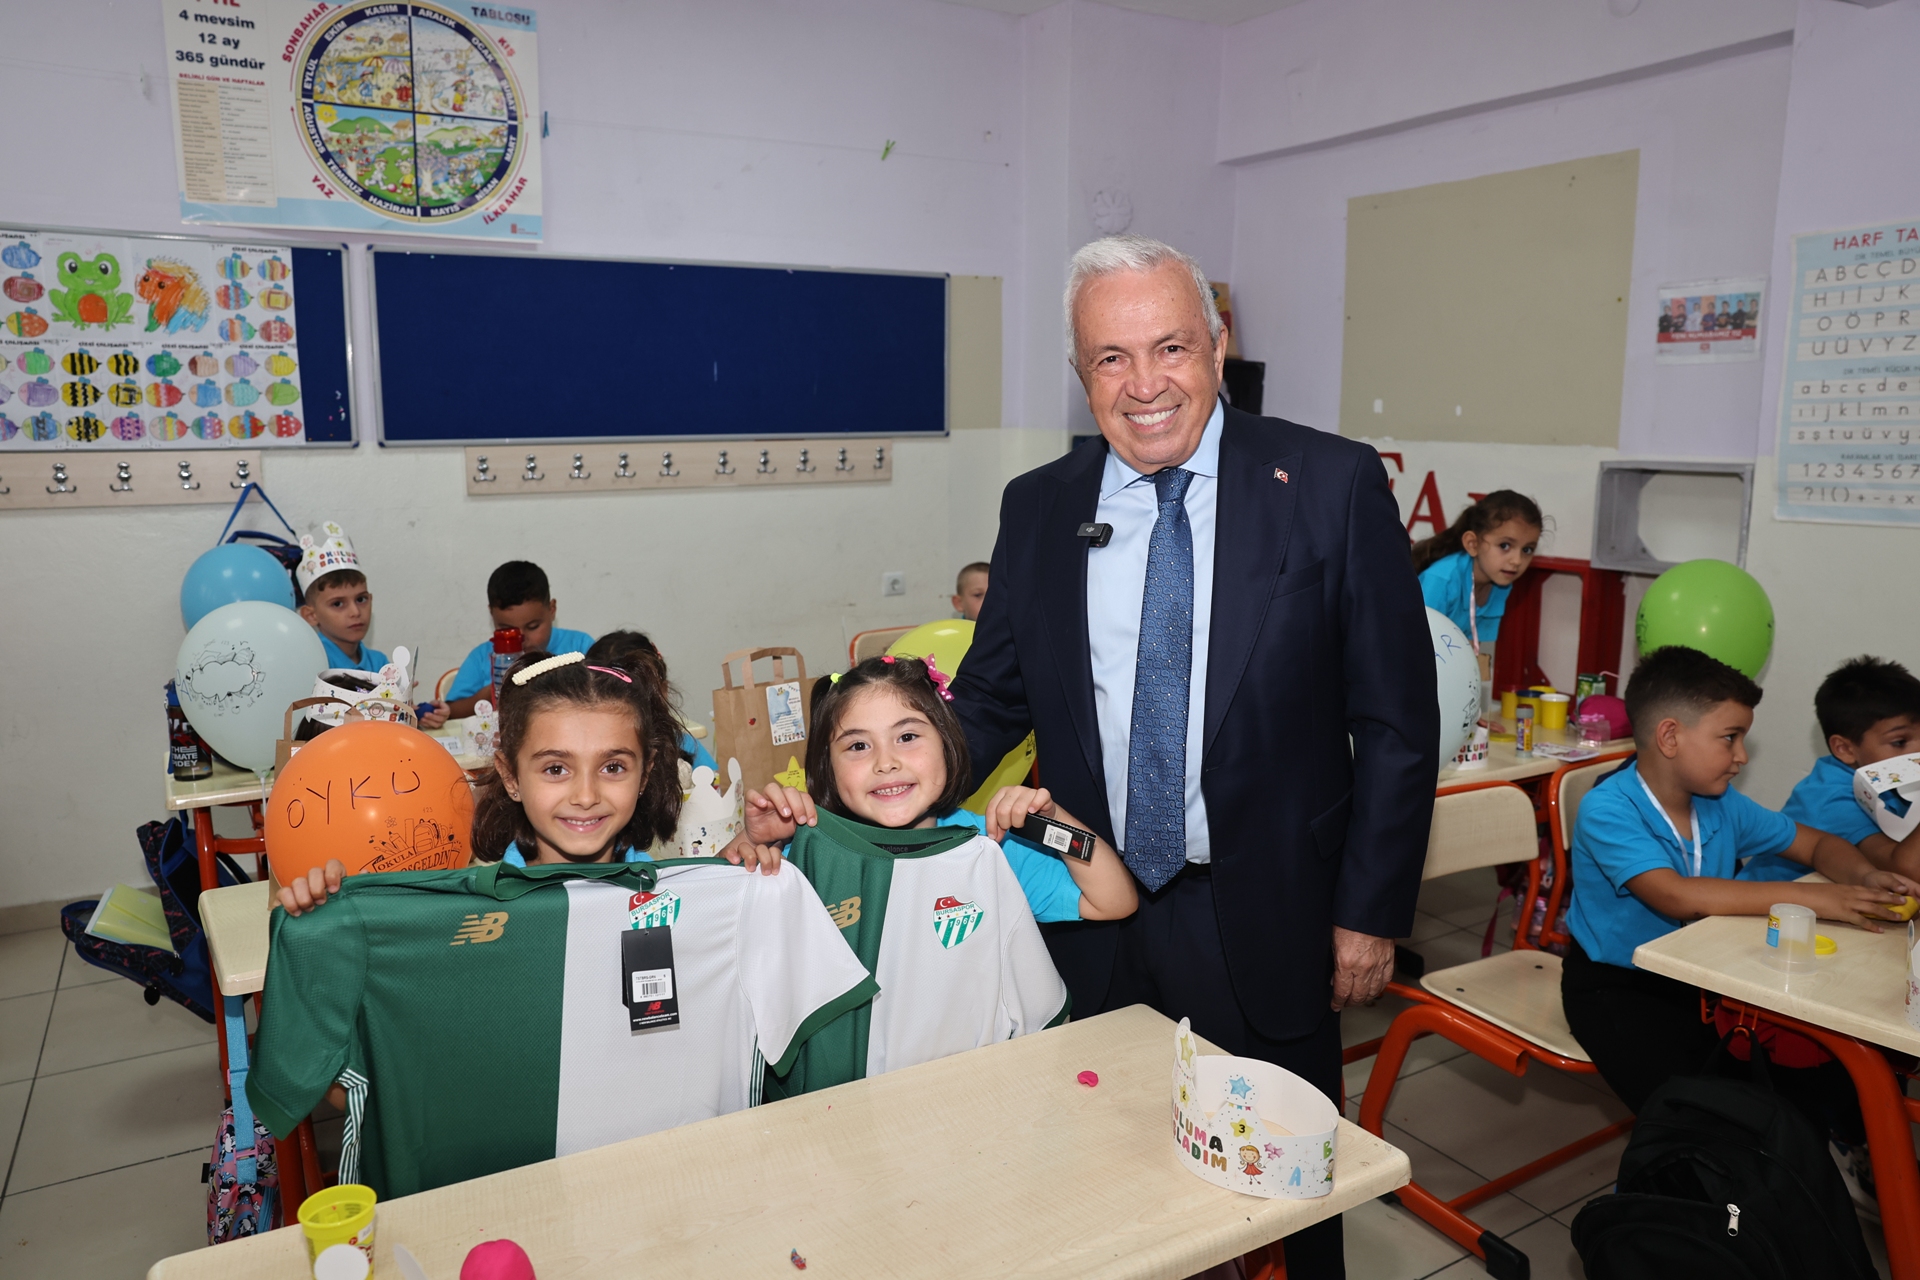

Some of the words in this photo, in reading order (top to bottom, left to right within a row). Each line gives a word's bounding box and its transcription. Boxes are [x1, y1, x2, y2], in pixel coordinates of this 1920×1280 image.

[178, 9, 189, 21] 4
[194, 13, 255, 29] mevsim
[364, 5, 398, 16] KASIM
[418, 8, 457, 28] ARALIK
[471, 6, 530, 26] TABLOSU
[199, 32, 216, 44] 12
[222, 37, 240, 49] ay
[282, 2, 329, 62] SONBAHAR
[324, 20, 348, 42] EKİM
[471, 36, 496, 62] OCAK
[498, 36, 516, 57] KIŞ
[176, 50, 204, 64] 365
[210, 55, 265, 70] gündür
[304, 58, 318, 90] EYLÜL
[500, 78, 516, 112] ŞUBAT
[304, 105, 326, 154] AĞUSTOS
[504, 134, 516, 162] MART
[312, 175, 334, 198] YAZ
[327, 159, 364, 196] TEMMUZ
[475, 178, 498, 201] NİSAN
[368, 196, 414, 216] HAZİRAN
[430, 204, 460, 216] MAYIS
[483, 177, 528, 224] İLKBAHAR
[1833, 231, 1884, 250] HARF
[1815, 268, 1828, 282] A
[1836, 265, 1846, 281] B
[1854, 263, 1868, 279] C
[1876, 260, 1892, 279] Ç
[1902, 258, 1916, 274] D
[1814, 292, 1828, 307] H
[1874, 286, 1885, 302] J
[1899, 284, 1911, 300] K
[1817, 316, 1832, 331] O
[1845, 311, 1860, 330] Ö
[1874, 312, 1885, 327] P
[1900, 310, 1910, 326] R
[1812, 341, 1826, 356] U
[1834, 336, 1849, 354] Ü
[1860, 338, 1873, 352] V
[1883, 336, 1894, 352] Y
[1902, 334, 1917, 350] Z
[1802, 385, 1811, 394] a
[1820, 380, 1830, 394] b
[1840, 384, 1848, 393] c
[1858, 382, 1866, 394] ç
[1877, 377, 1887, 392] d
[1898, 381, 1908, 391] e
[1824, 404, 1830, 422] j
[1840, 402, 1847, 416] k
[1872, 406, 1887, 416] m
[1898, 406, 1909, 415] n
[1798, 431, 1805, 440] s
[1812, 430, 1820, 442] ş
[1829, 428, 1834, 440] t
[1843, 431, 1853, 440] u
[1862, 428, 1872, 440] ü
[1882, 430, 1891, 439] v
[1899, 430, 1910, 446] y
[1804, 463, 1810, 477] 1
[1817, 462, 1828, 478] 2
[1834, 463, 1845, 478] 3
[1852, 464, 1865, 477] 4
[1874, 463, 1884, 478] 5
[1892, 464, 1902, 479] 6
[1909, 464, 1920, 478] 7
[287, 758, 420, 828] ÖYKÜ
[701, 827, 706, 836] 3
[378, 850, 414, 870] OKULA
[631, 892, 670, 916] BURSASPOR
[936, 904, 974, 916] BURSASPOR
[950, 916, 975, 928] 1963
[1182, 1090, 1187, 1100] 2
[1238, 1124, 1246, 1134] 3
[1324, 1140, 1333, 1160] B
[1288, 1166, 1302, 1186] A
